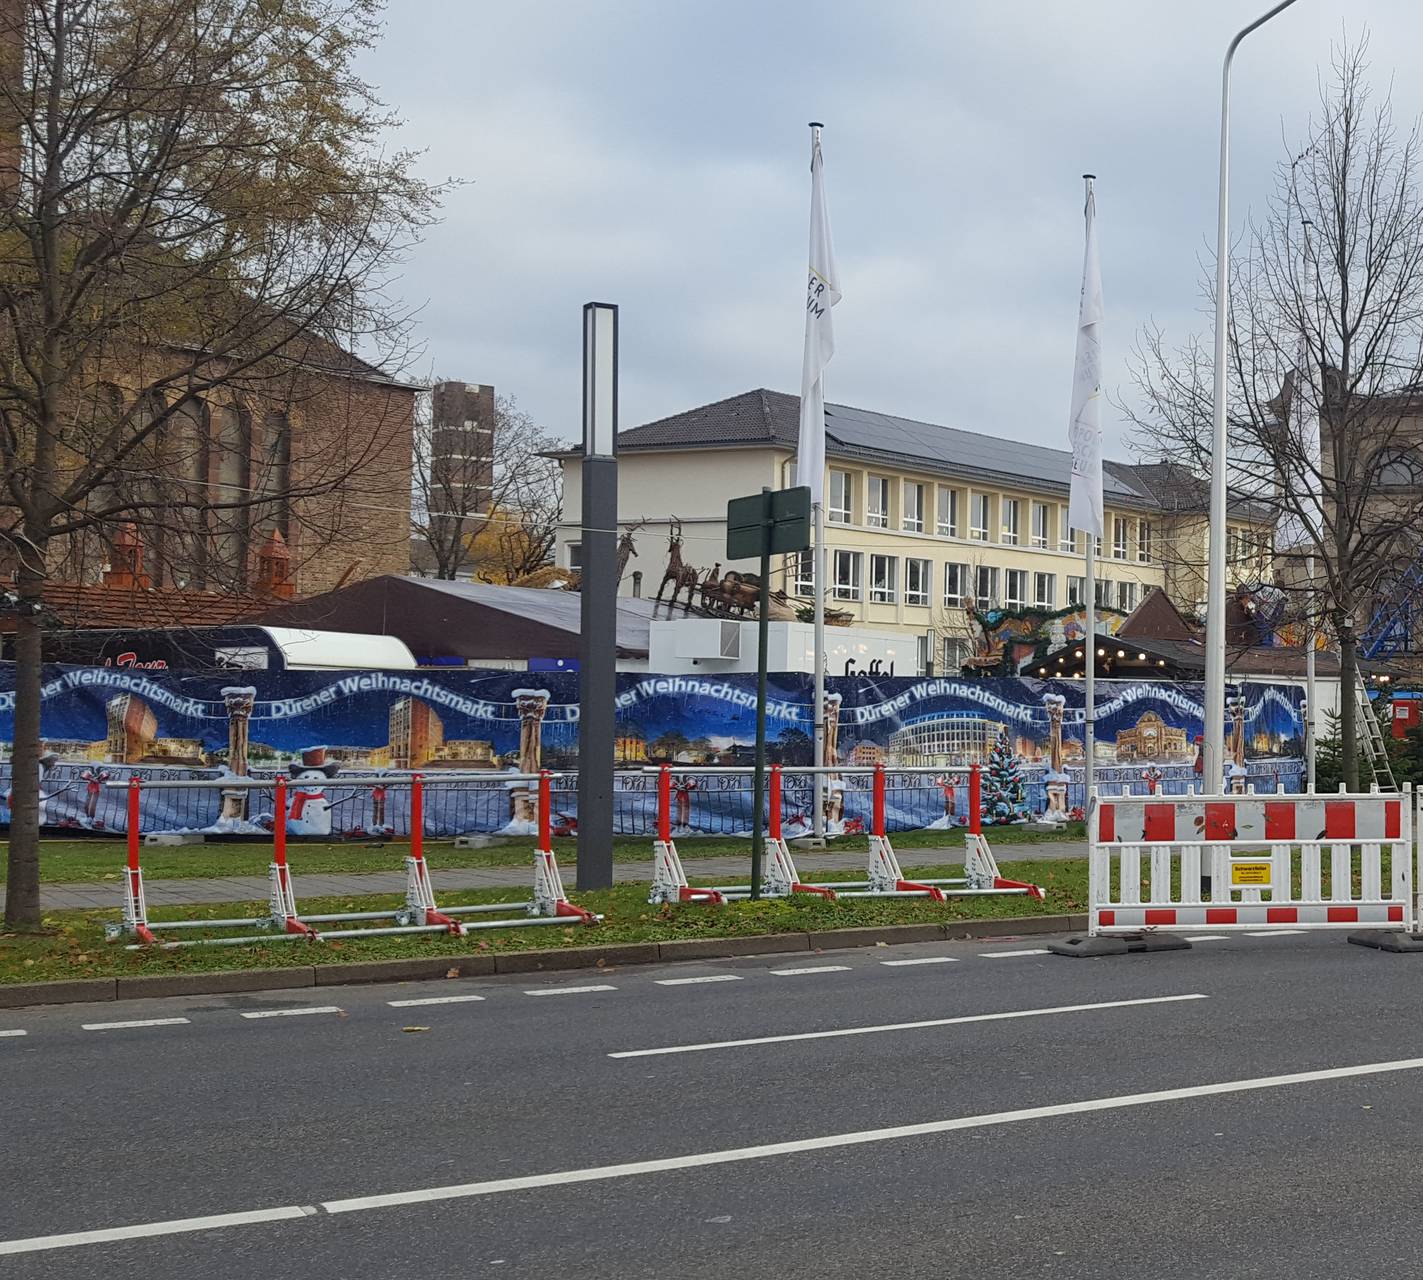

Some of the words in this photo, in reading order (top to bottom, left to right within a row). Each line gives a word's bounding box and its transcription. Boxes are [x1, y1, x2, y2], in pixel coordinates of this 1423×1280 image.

[63, 667, 205, 717] Weihnachtsmarkt
[271, 685, 337, 717] Dürener
[338, 672, 497, 719] Weihnachtsmarkt
[856, 693, 911, 723] Dürener
[911, 679, 1032, 721] Weihnachtsmarkt
[1075, 698, 1124, 723] Drener
